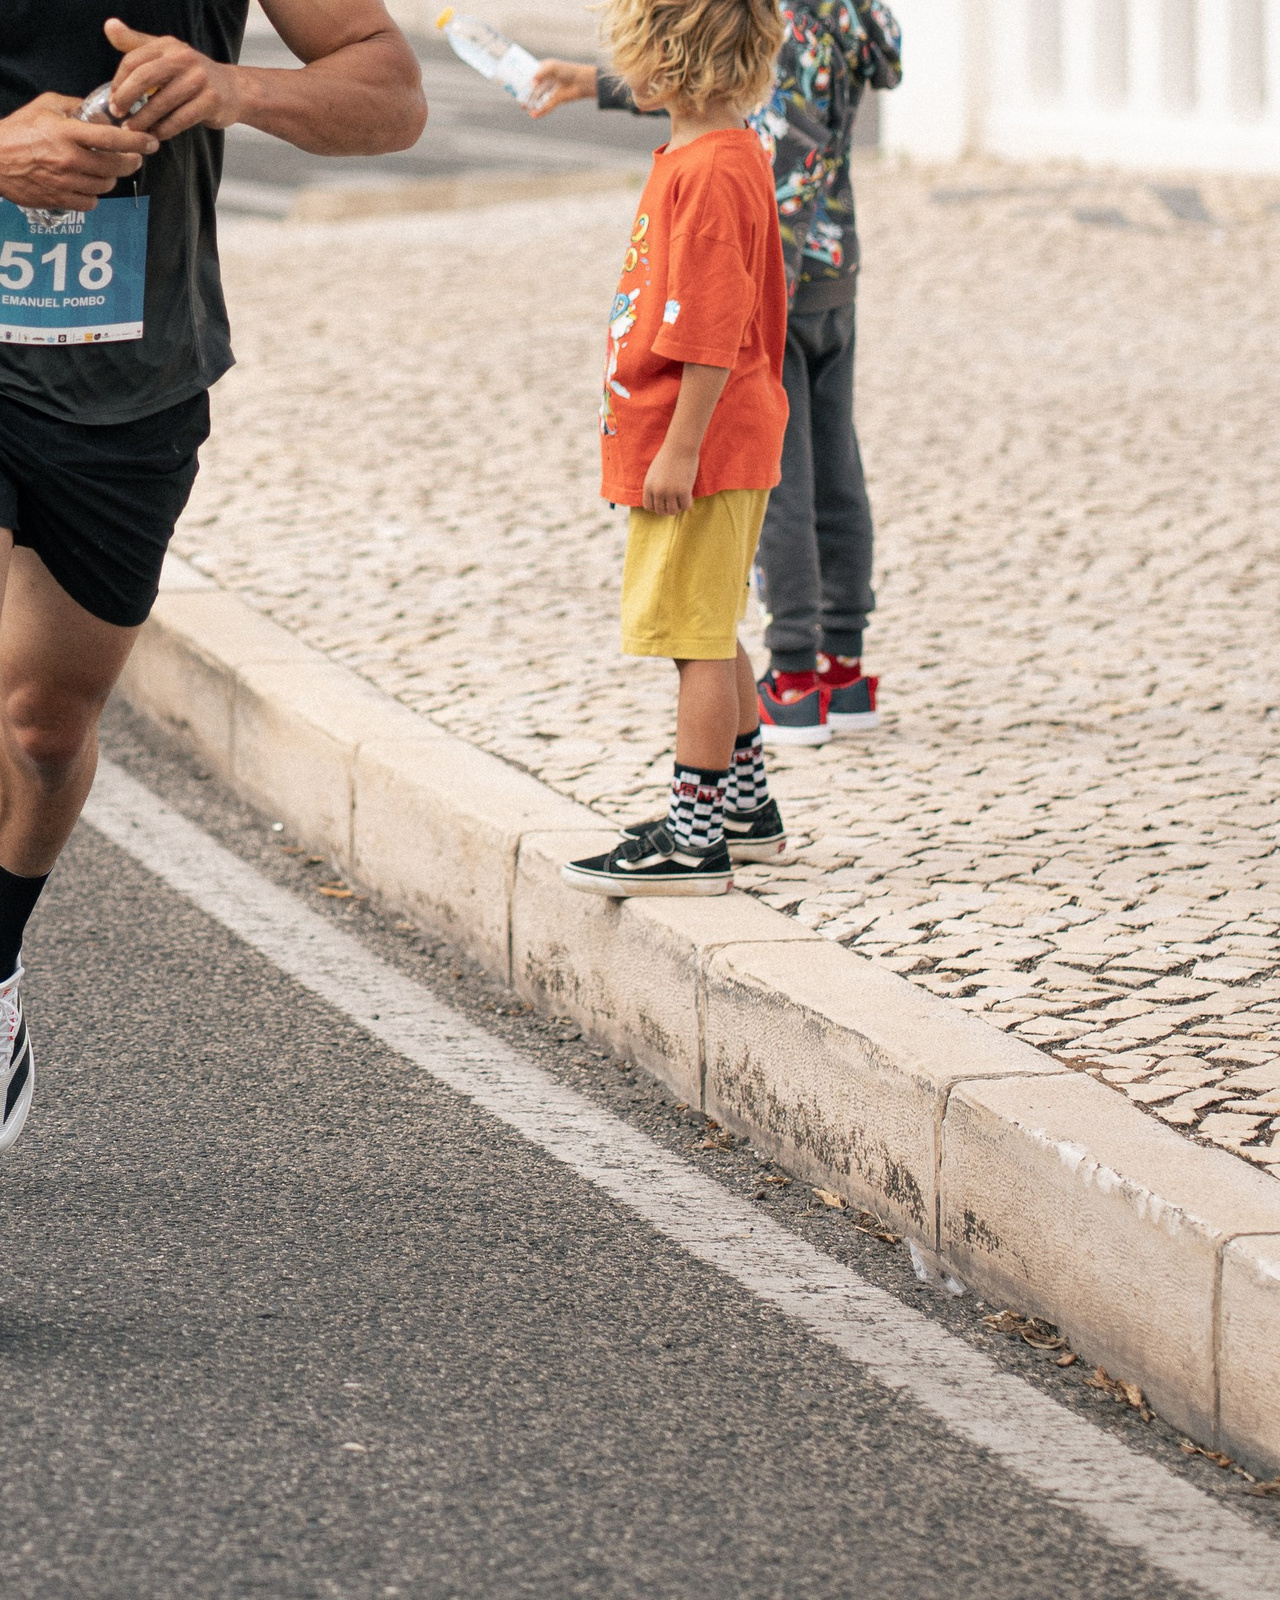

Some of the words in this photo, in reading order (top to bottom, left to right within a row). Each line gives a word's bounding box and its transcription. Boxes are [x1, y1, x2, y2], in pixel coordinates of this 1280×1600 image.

[30, 224, 82, 234] SEALAND
[1, 294, 60, 308] EMANUEL
[63, 295, 105, 307] POMBO
